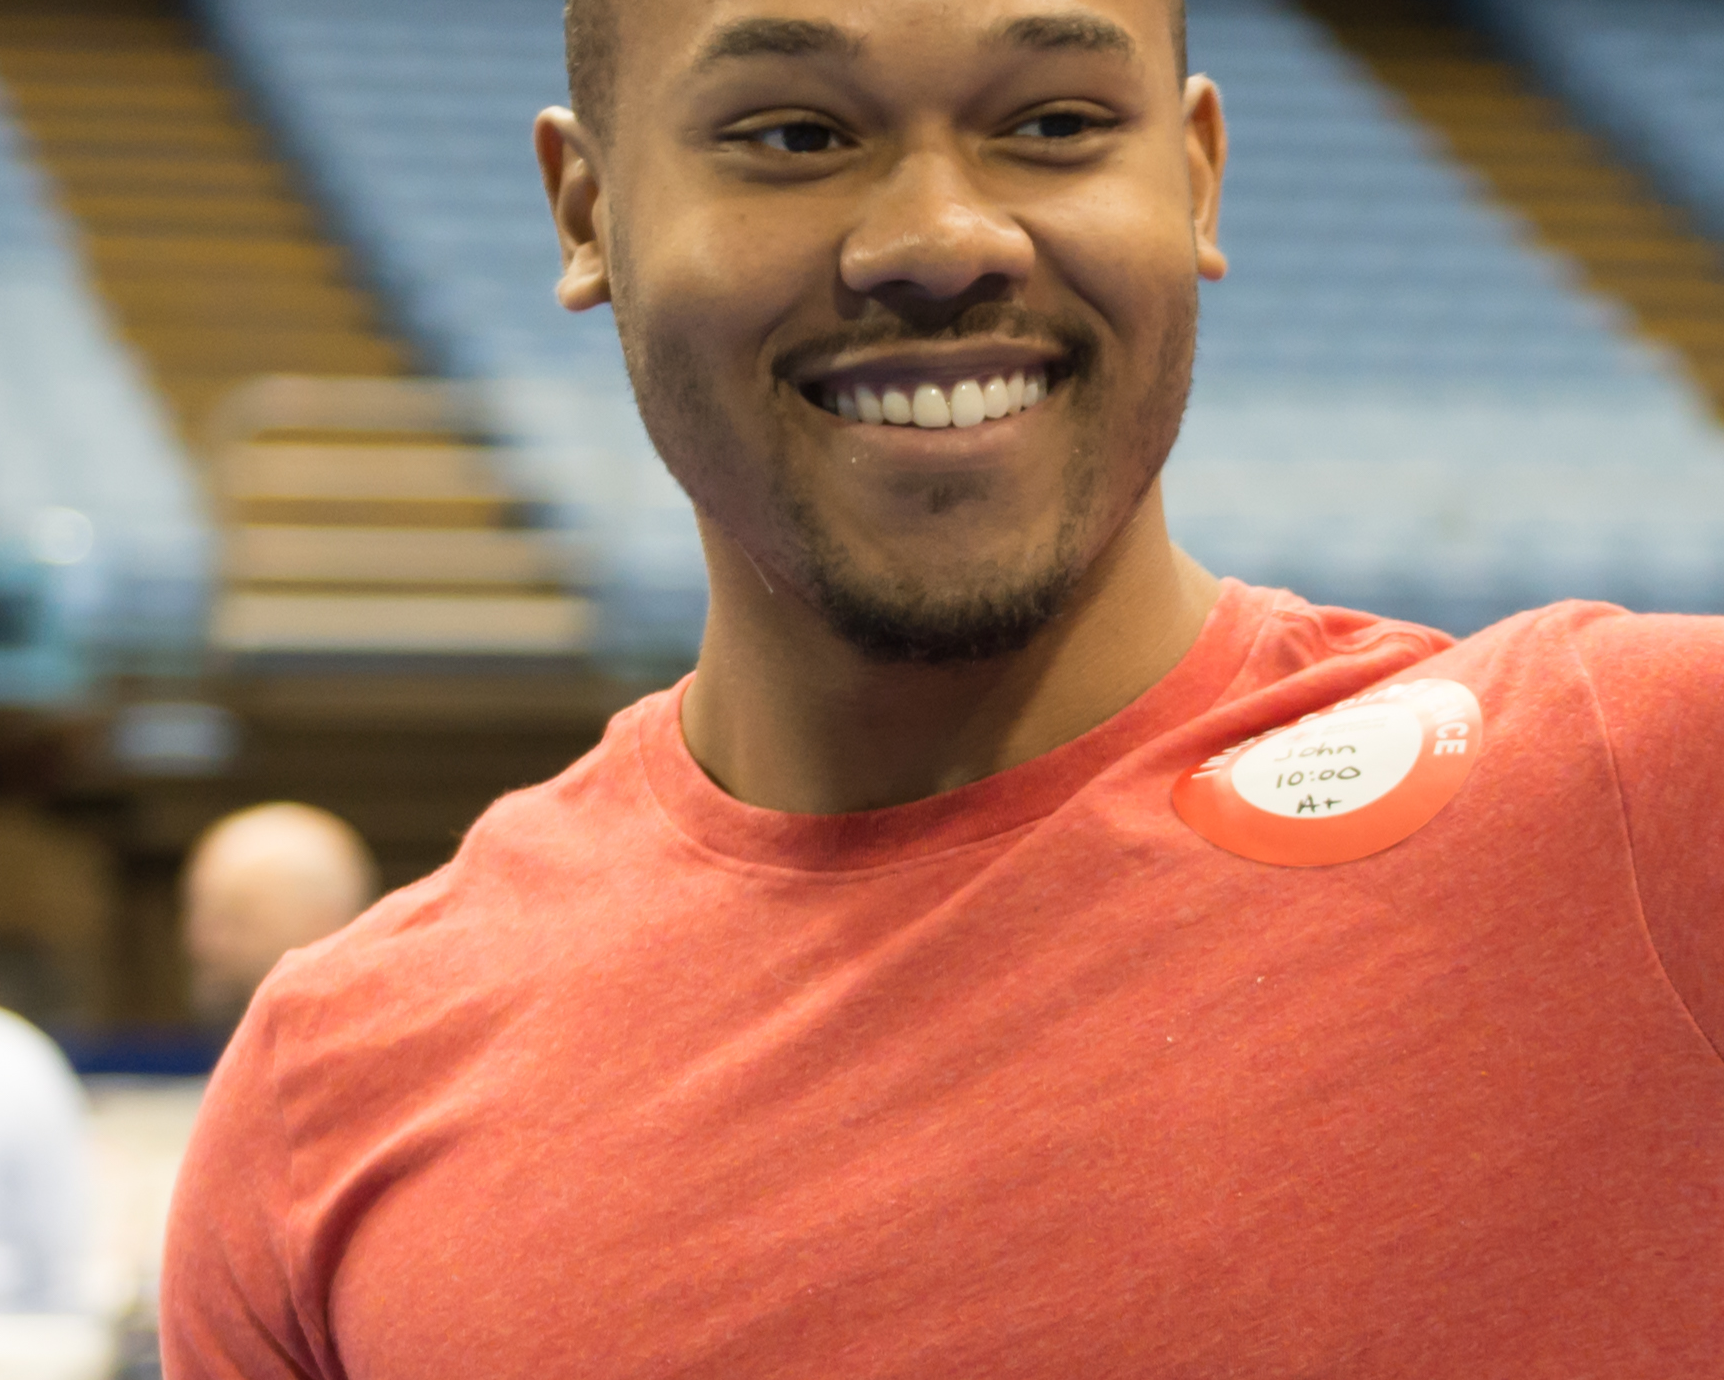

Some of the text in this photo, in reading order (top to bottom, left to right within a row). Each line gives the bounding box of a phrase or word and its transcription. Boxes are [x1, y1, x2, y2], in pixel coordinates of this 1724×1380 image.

[1274, 741, 1357, 762] John
[1276, 765, 1362, 789] 10:00
[1296, 793, 1343, 815] A+
